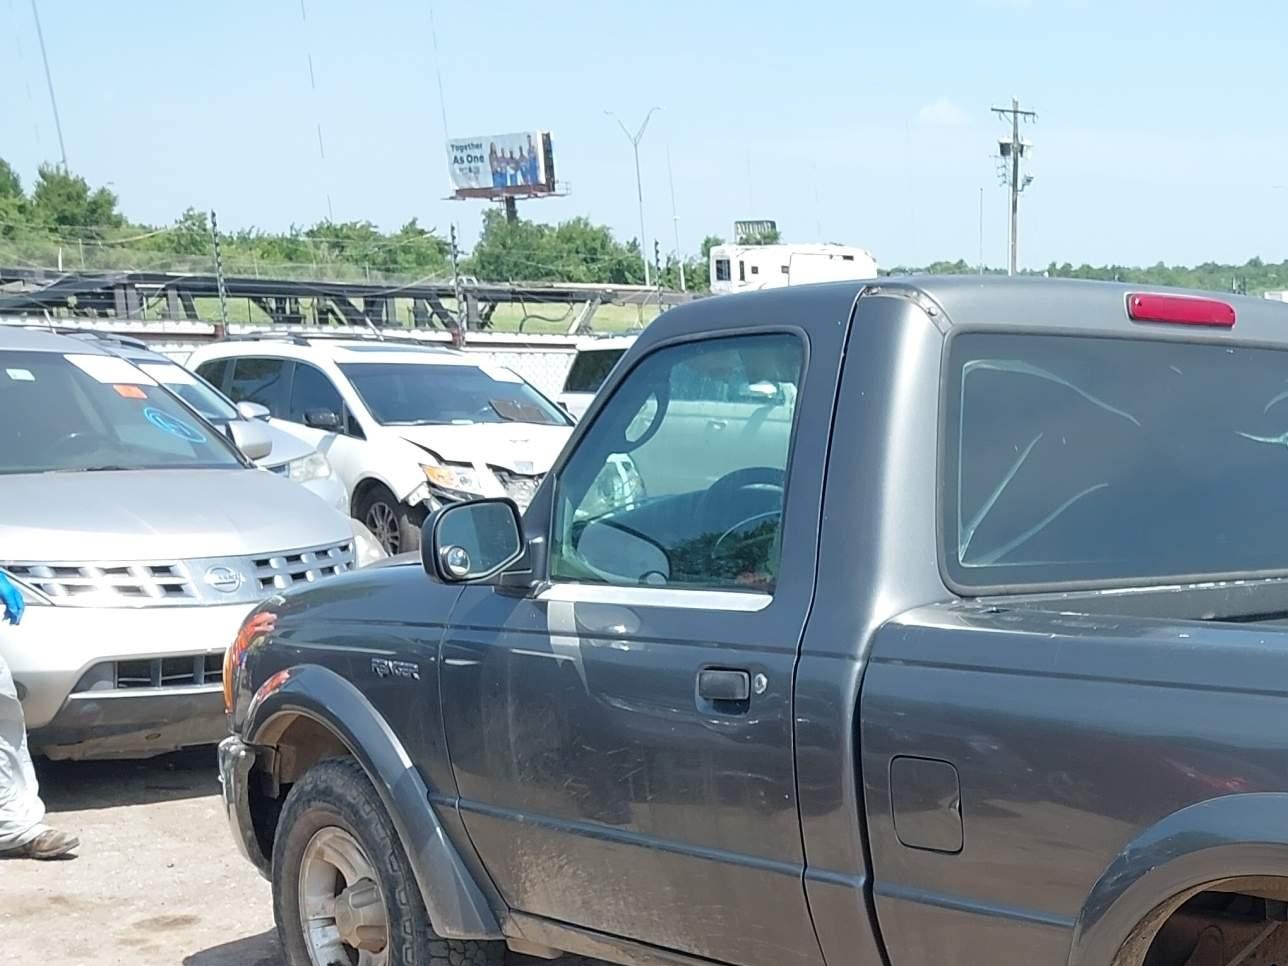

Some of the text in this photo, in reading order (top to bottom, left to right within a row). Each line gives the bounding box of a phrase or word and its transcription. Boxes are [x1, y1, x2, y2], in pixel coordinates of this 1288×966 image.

[450, 143, 483, 153] Together
[453, 154, 485, 165] As One
